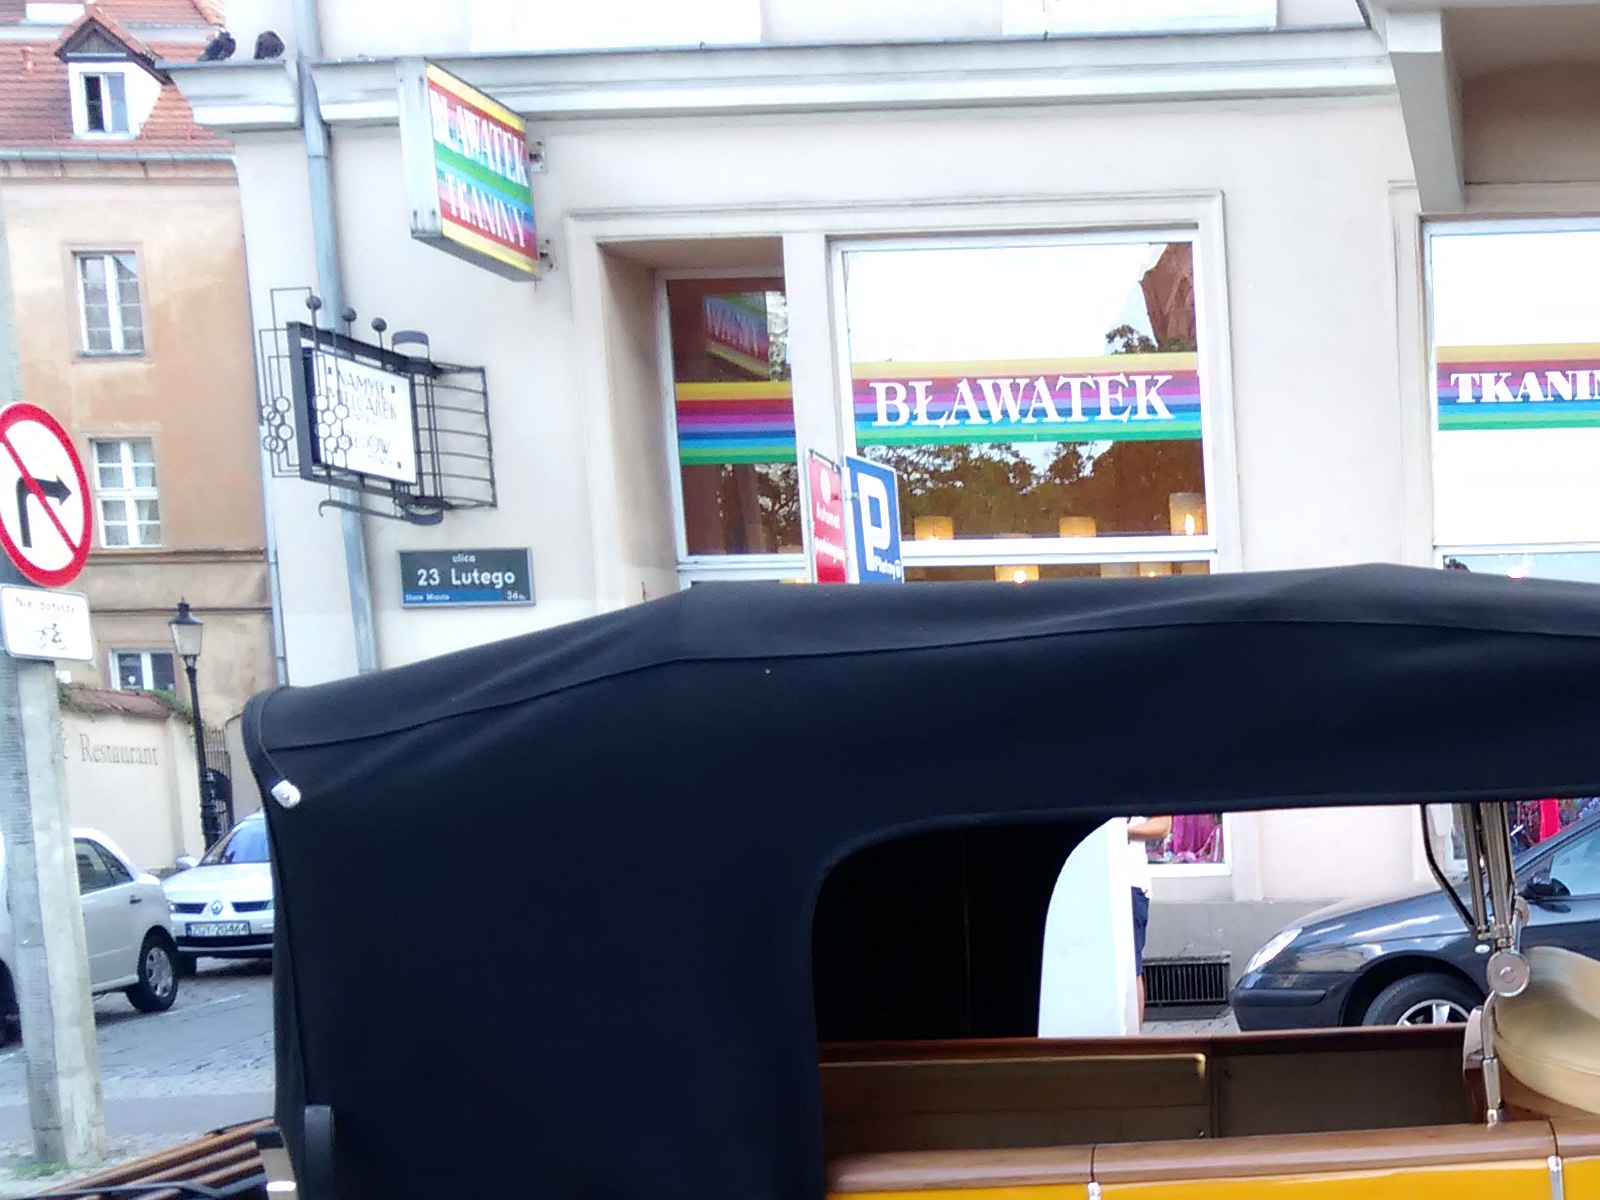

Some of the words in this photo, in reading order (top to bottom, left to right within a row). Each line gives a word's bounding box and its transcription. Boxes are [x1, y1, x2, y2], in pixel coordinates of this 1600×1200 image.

[444, 173, 525, 248] TKANINY
[869, 372, 1177, 428] BŁAWATEK
[452, 554, 476, 563] ulica
[417, 568, 440, 586] 23
[451, 568, 515, 589] Lutego
[79, 733, 158, 766] Restaurant
